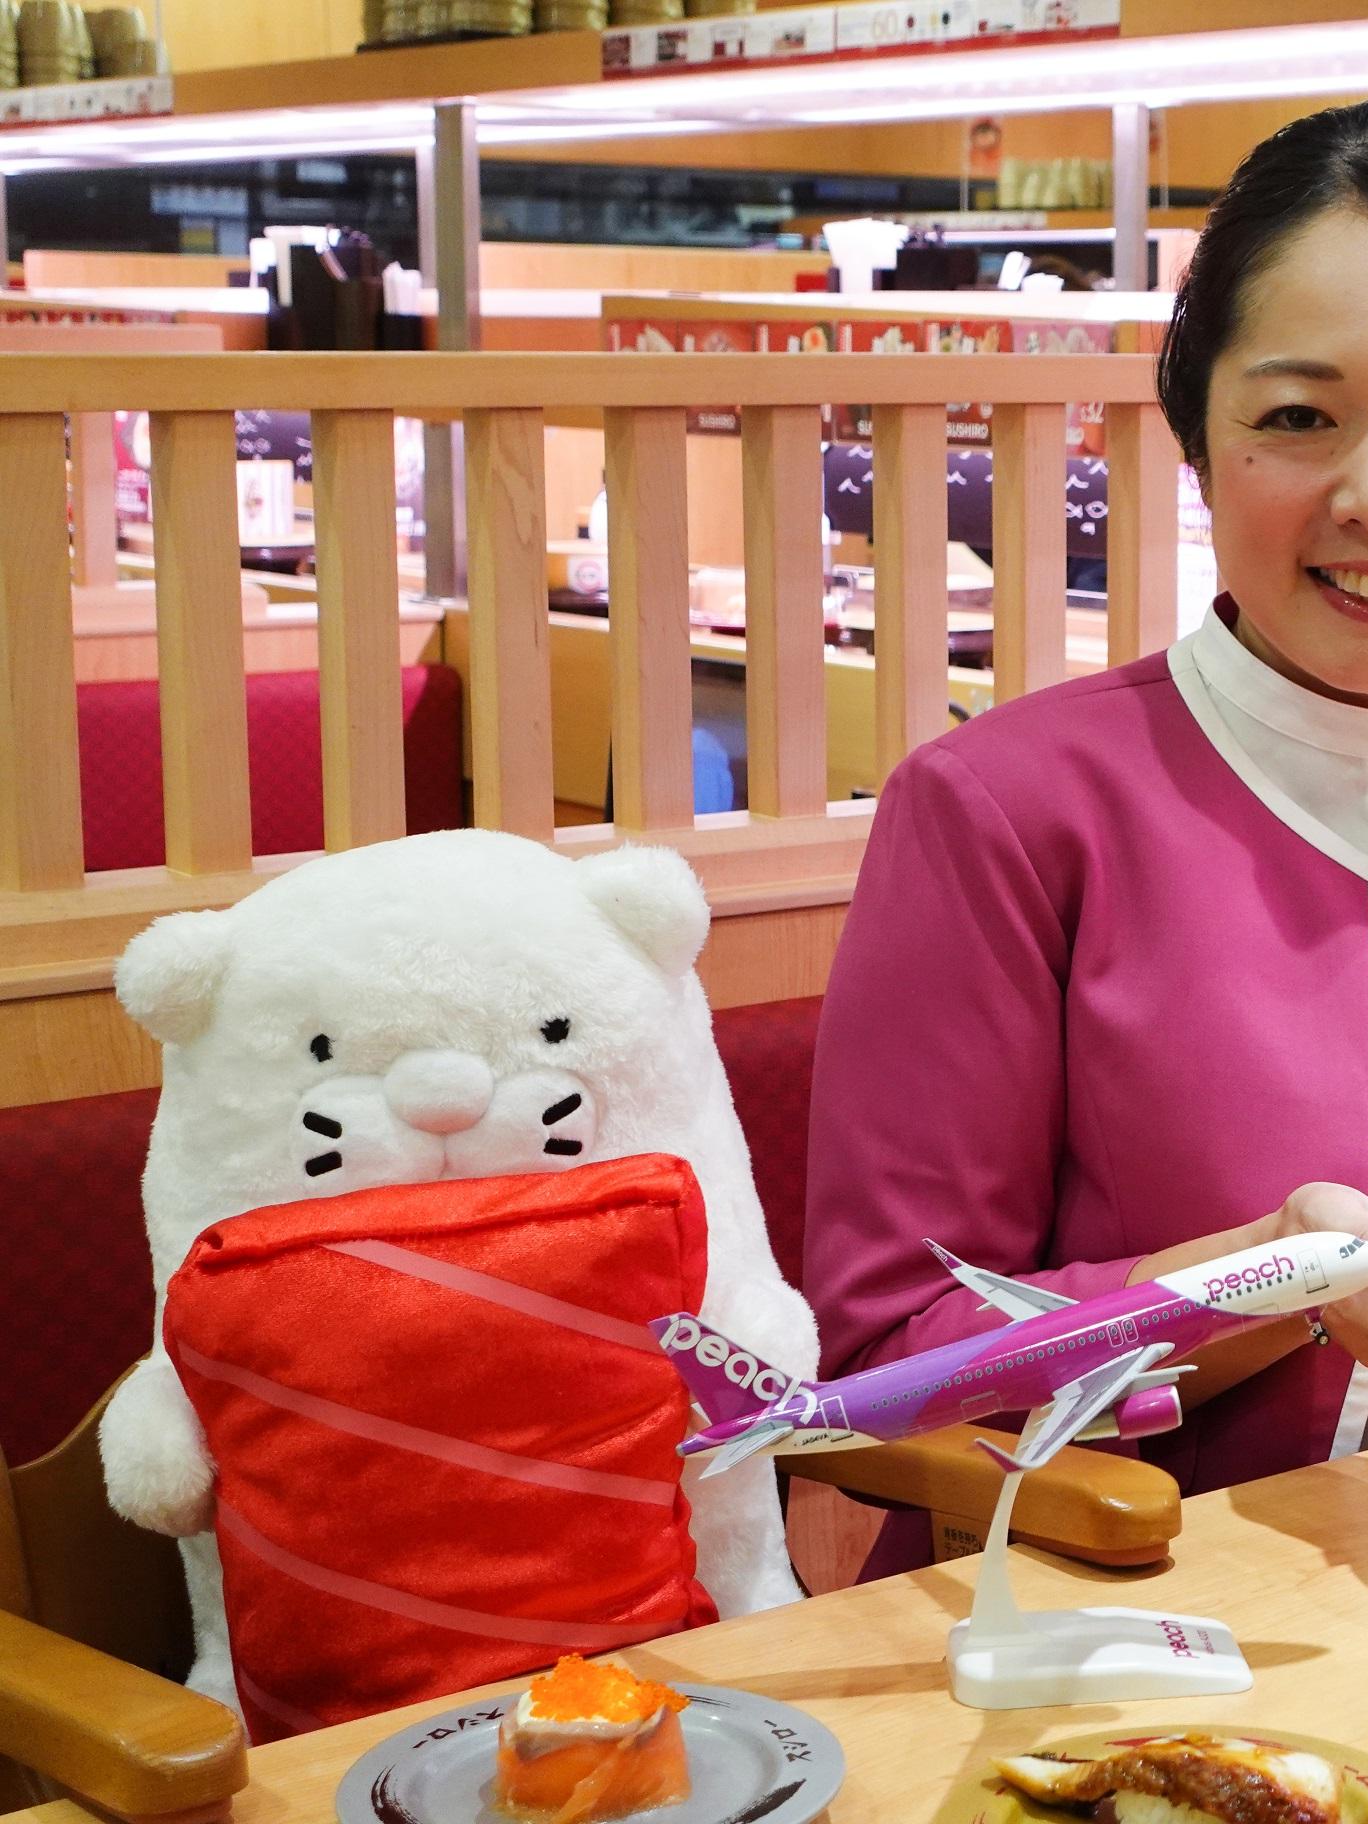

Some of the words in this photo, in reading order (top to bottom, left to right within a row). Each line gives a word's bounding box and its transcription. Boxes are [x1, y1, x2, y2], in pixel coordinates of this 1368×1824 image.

[1203, 1253, 1296, 1304] peach
[658, 1315, 819, 1426] peach
[1155, 1620, 1201, 1659] peach
[412, 1706, 505, 1751] スシロー
[763, 1718, 815, 1764] スシロー
